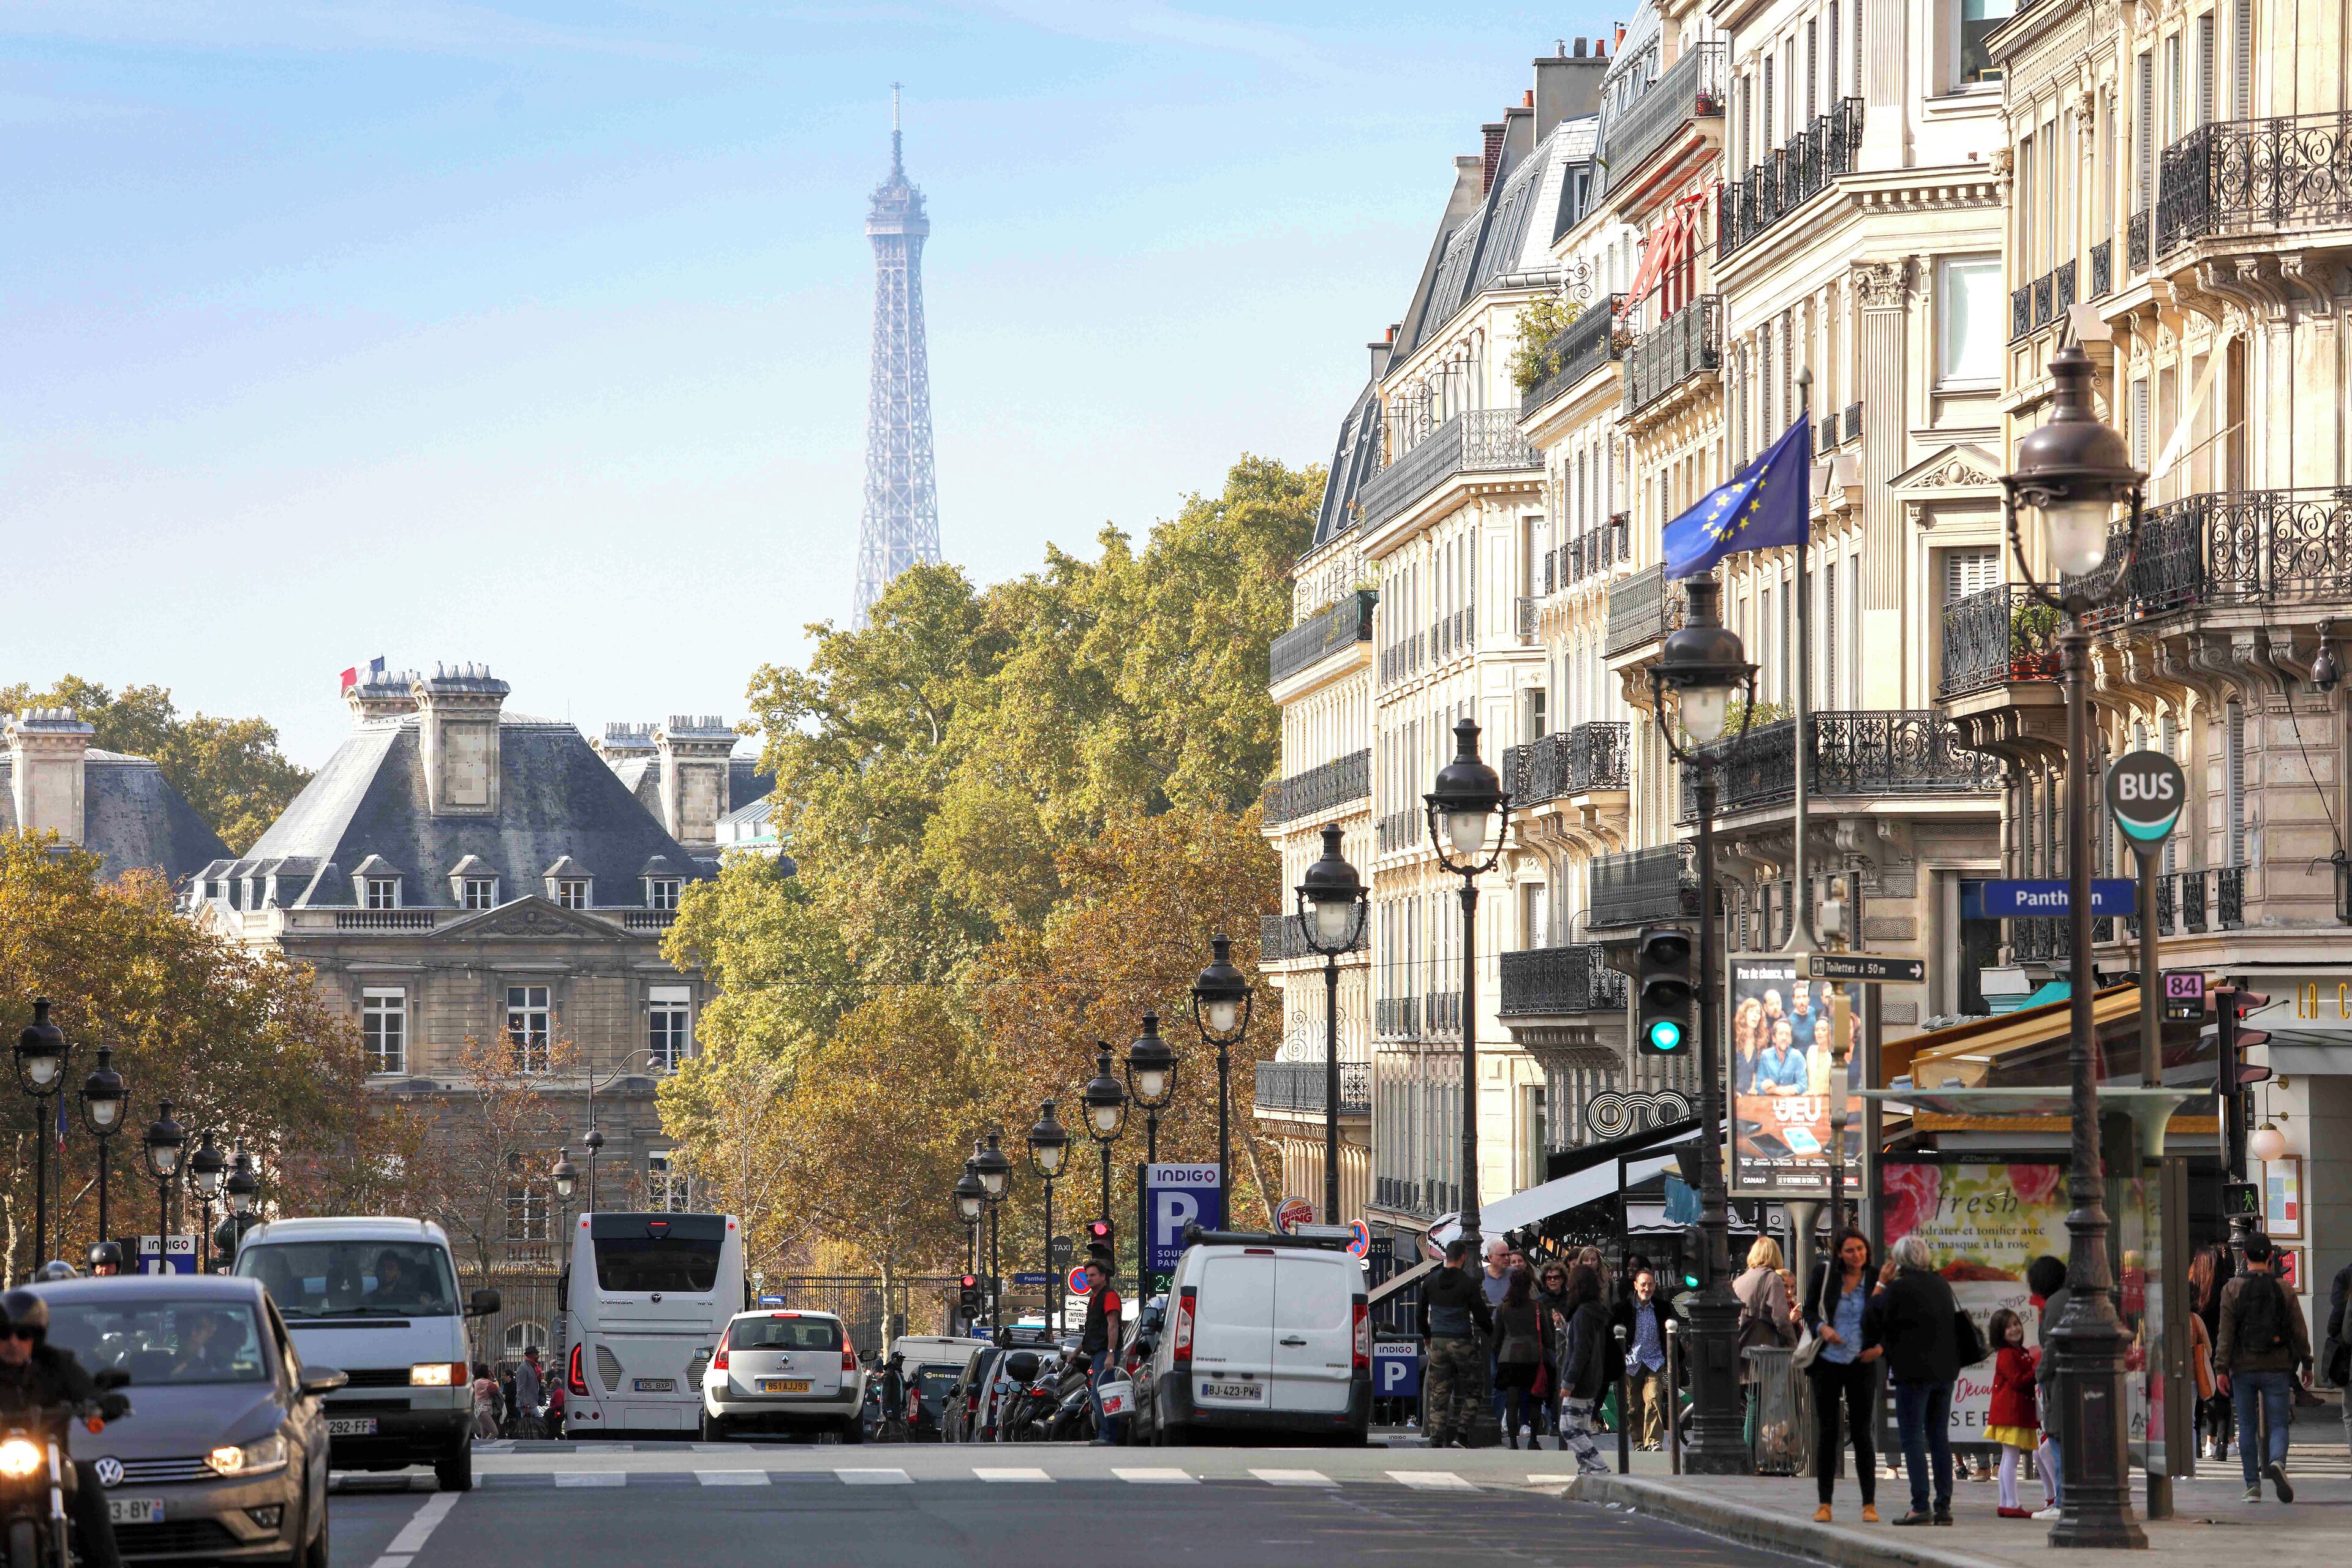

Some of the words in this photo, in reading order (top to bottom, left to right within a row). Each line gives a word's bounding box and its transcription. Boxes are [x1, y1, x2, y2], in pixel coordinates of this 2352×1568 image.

[2119, 772, 2174, 801] BUS
[2016, 889, 2102, 907] Panthn
[1737, 967, 1749, 979] Pas
[1750, 968, 1758, 979] de
[1759, 968, 1784, 980] chance,
[1826, 962, 1856, 973] Toilettes
[1860, 963, 1864, 973] à
[1868, 963, 1878, 974] 50
[2171, 978, 2197, 995] 84
[2297, 983, 2318, 1019] LA
[2183, 1008, 2189, 1017] 7
[1773, 1099, 1785, 1110] LE
[1775, 1096, 1821, 1122] JEU
[1157, 1170, 1216, 1183] INDIGO
[1935, 1186, 2018, 1221] fresh
[1157, 1191, 1198, 1245] P
[1281, 1205, 1311, 1220] BURGER
[1909, 1225, 1959, 1237] Hydrater
[1963, 1226, 1973, 1235] et
[1977, 1224, 2018, 1235] tonifier
[148, 1240, 189, 1251] INIGO
[1939, 1241, 1980, 1251] masque
[1983, 1238, 1989, 1249] à
[1994, 1238, 2003, 1249] la
[1998, 1295, 2026, 1310] STOP
[1385, 1362, 1407, 1390] P
